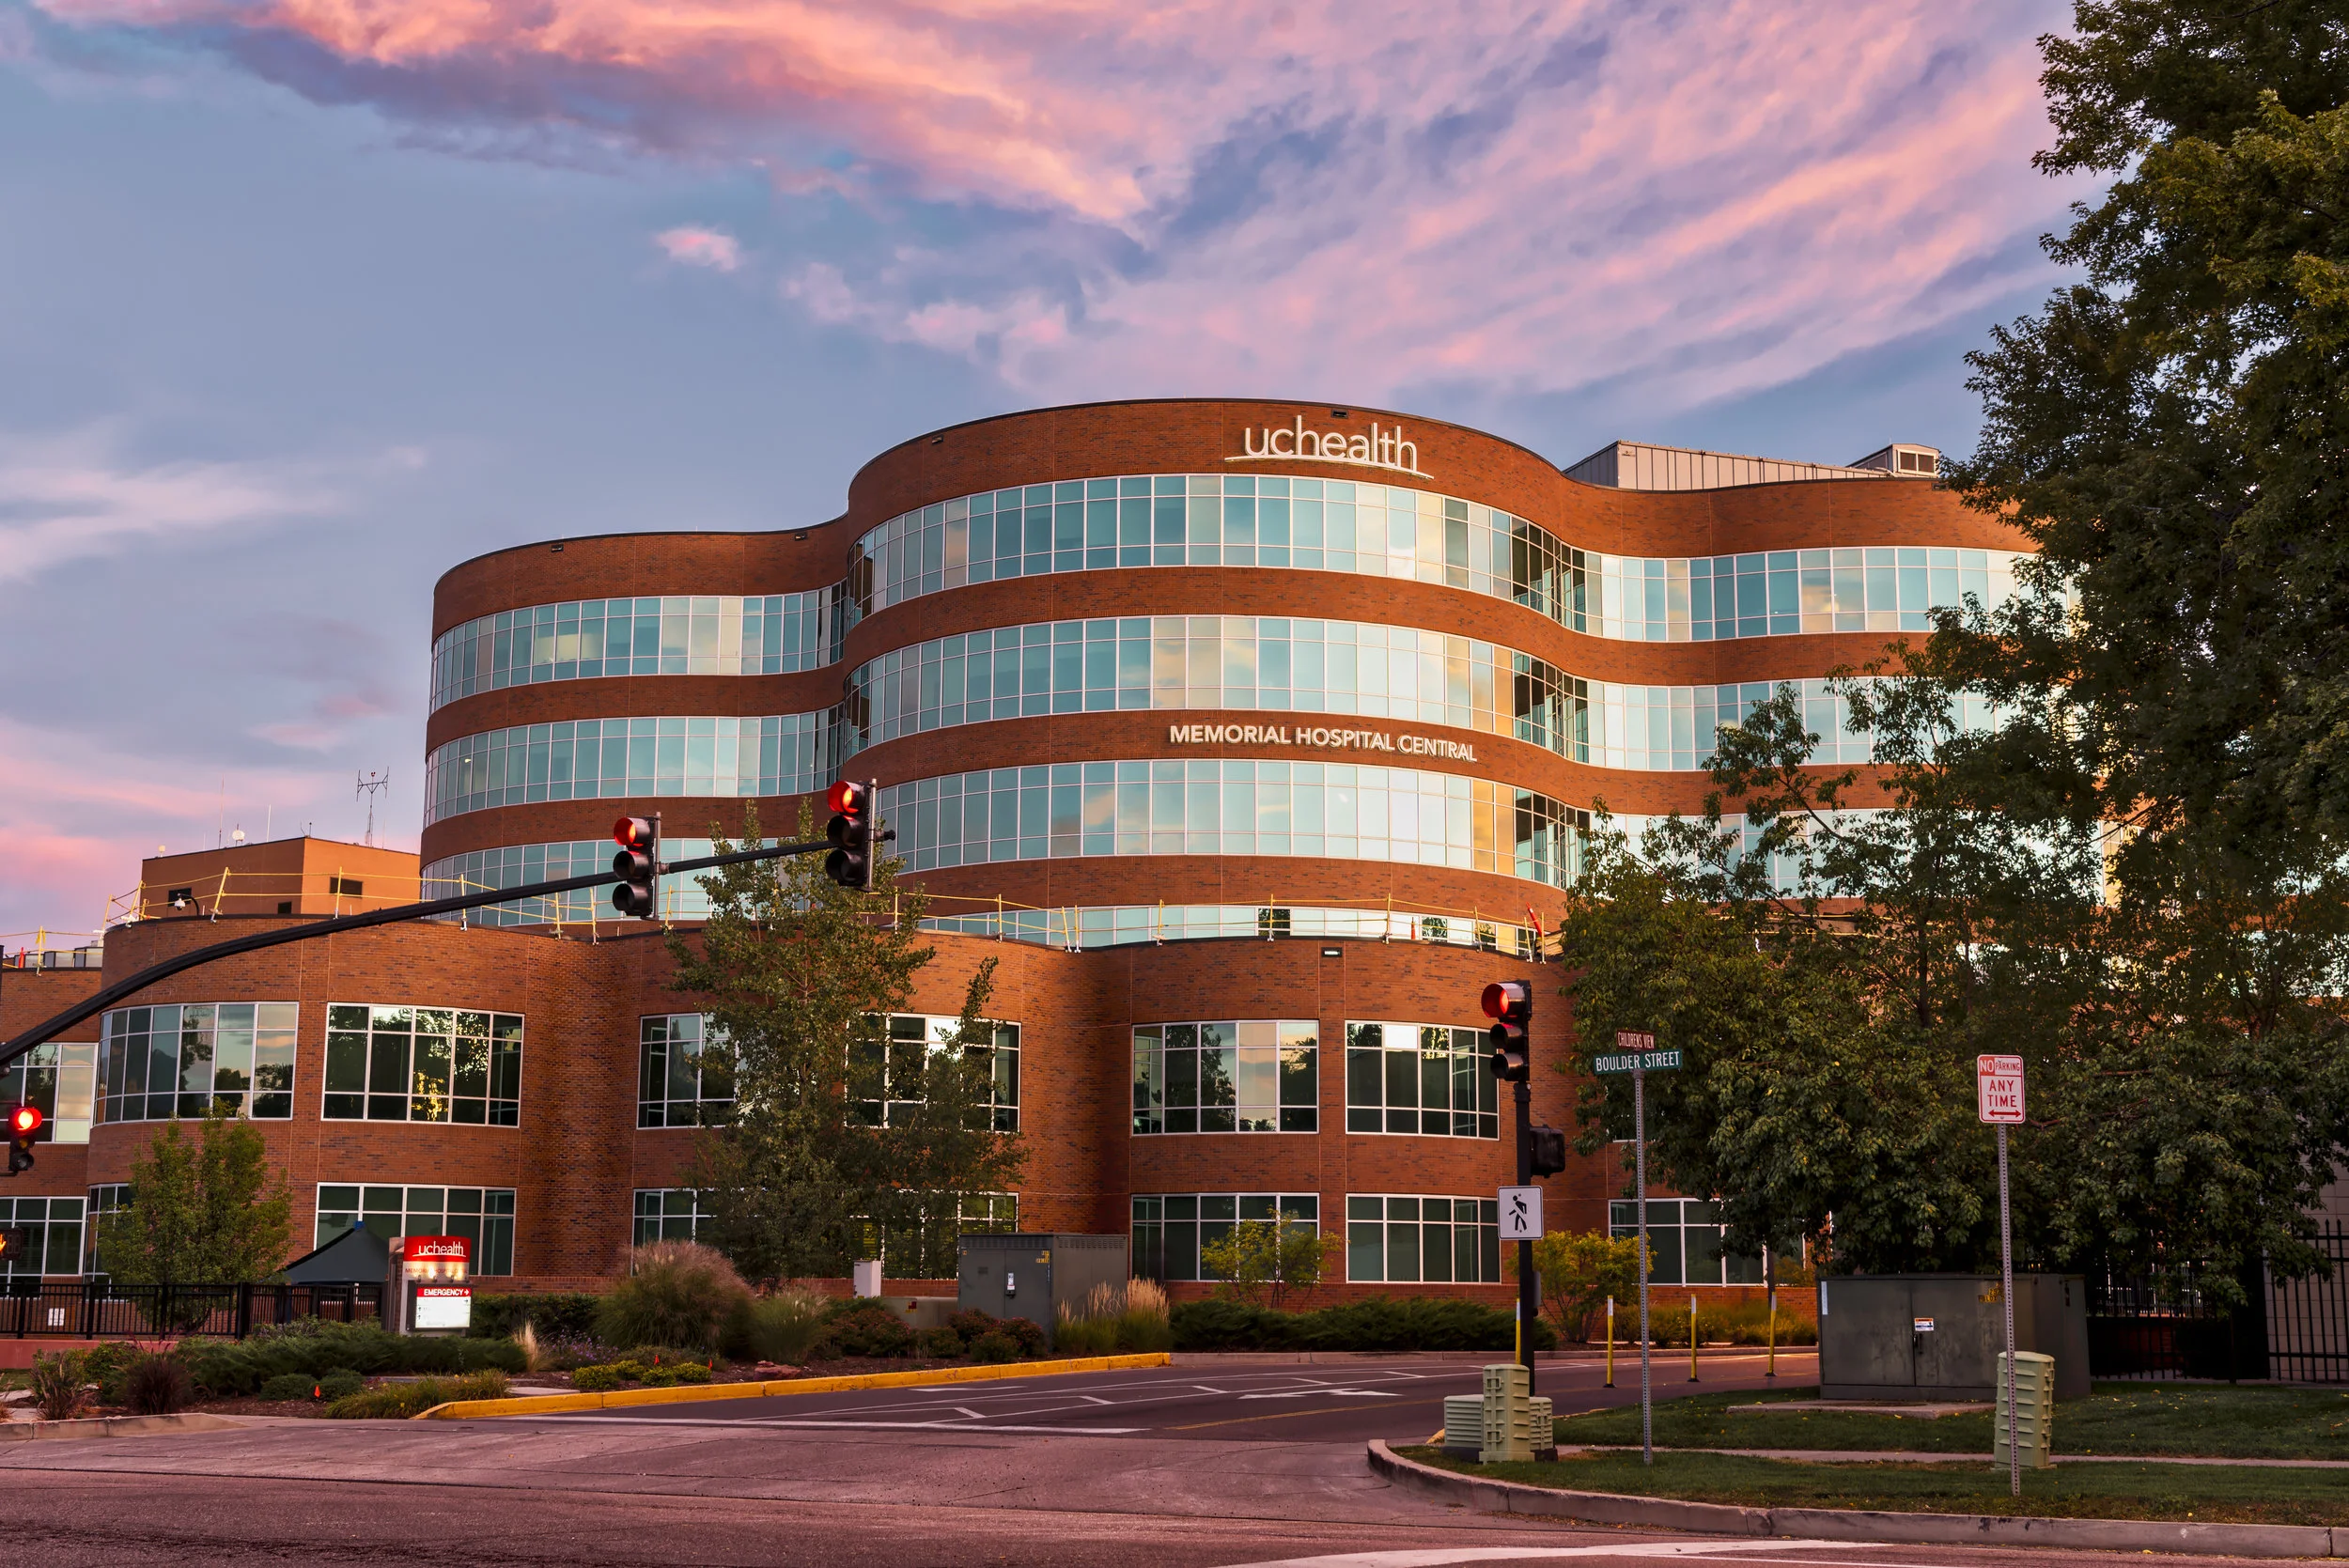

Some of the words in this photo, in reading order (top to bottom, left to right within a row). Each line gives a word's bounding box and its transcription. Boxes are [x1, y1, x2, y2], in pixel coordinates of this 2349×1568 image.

[1244, 414, 1418, 472] uchealth
[1170, 725, 1291, 745] MEMORIAL
[1295, 727, 1395, 752] HOSPITAL
[1396, 735, 1478, 763] CENTRAL
[1595, 1054, 1641, 1072] BOULDER
[1644, 1051, 1680, 1068] STREET
[1980, 1060, 1995, 1072] NO
[1996, 1062, 2020, 1071] PARKING
[1989, 1079, 2015, 1093] ANY
[1987, 1094, 2017, 1108] TIME
[418, 1240, 464, 1256] uchealth
[424, 1288, 464, 1296] EMERGENCY
